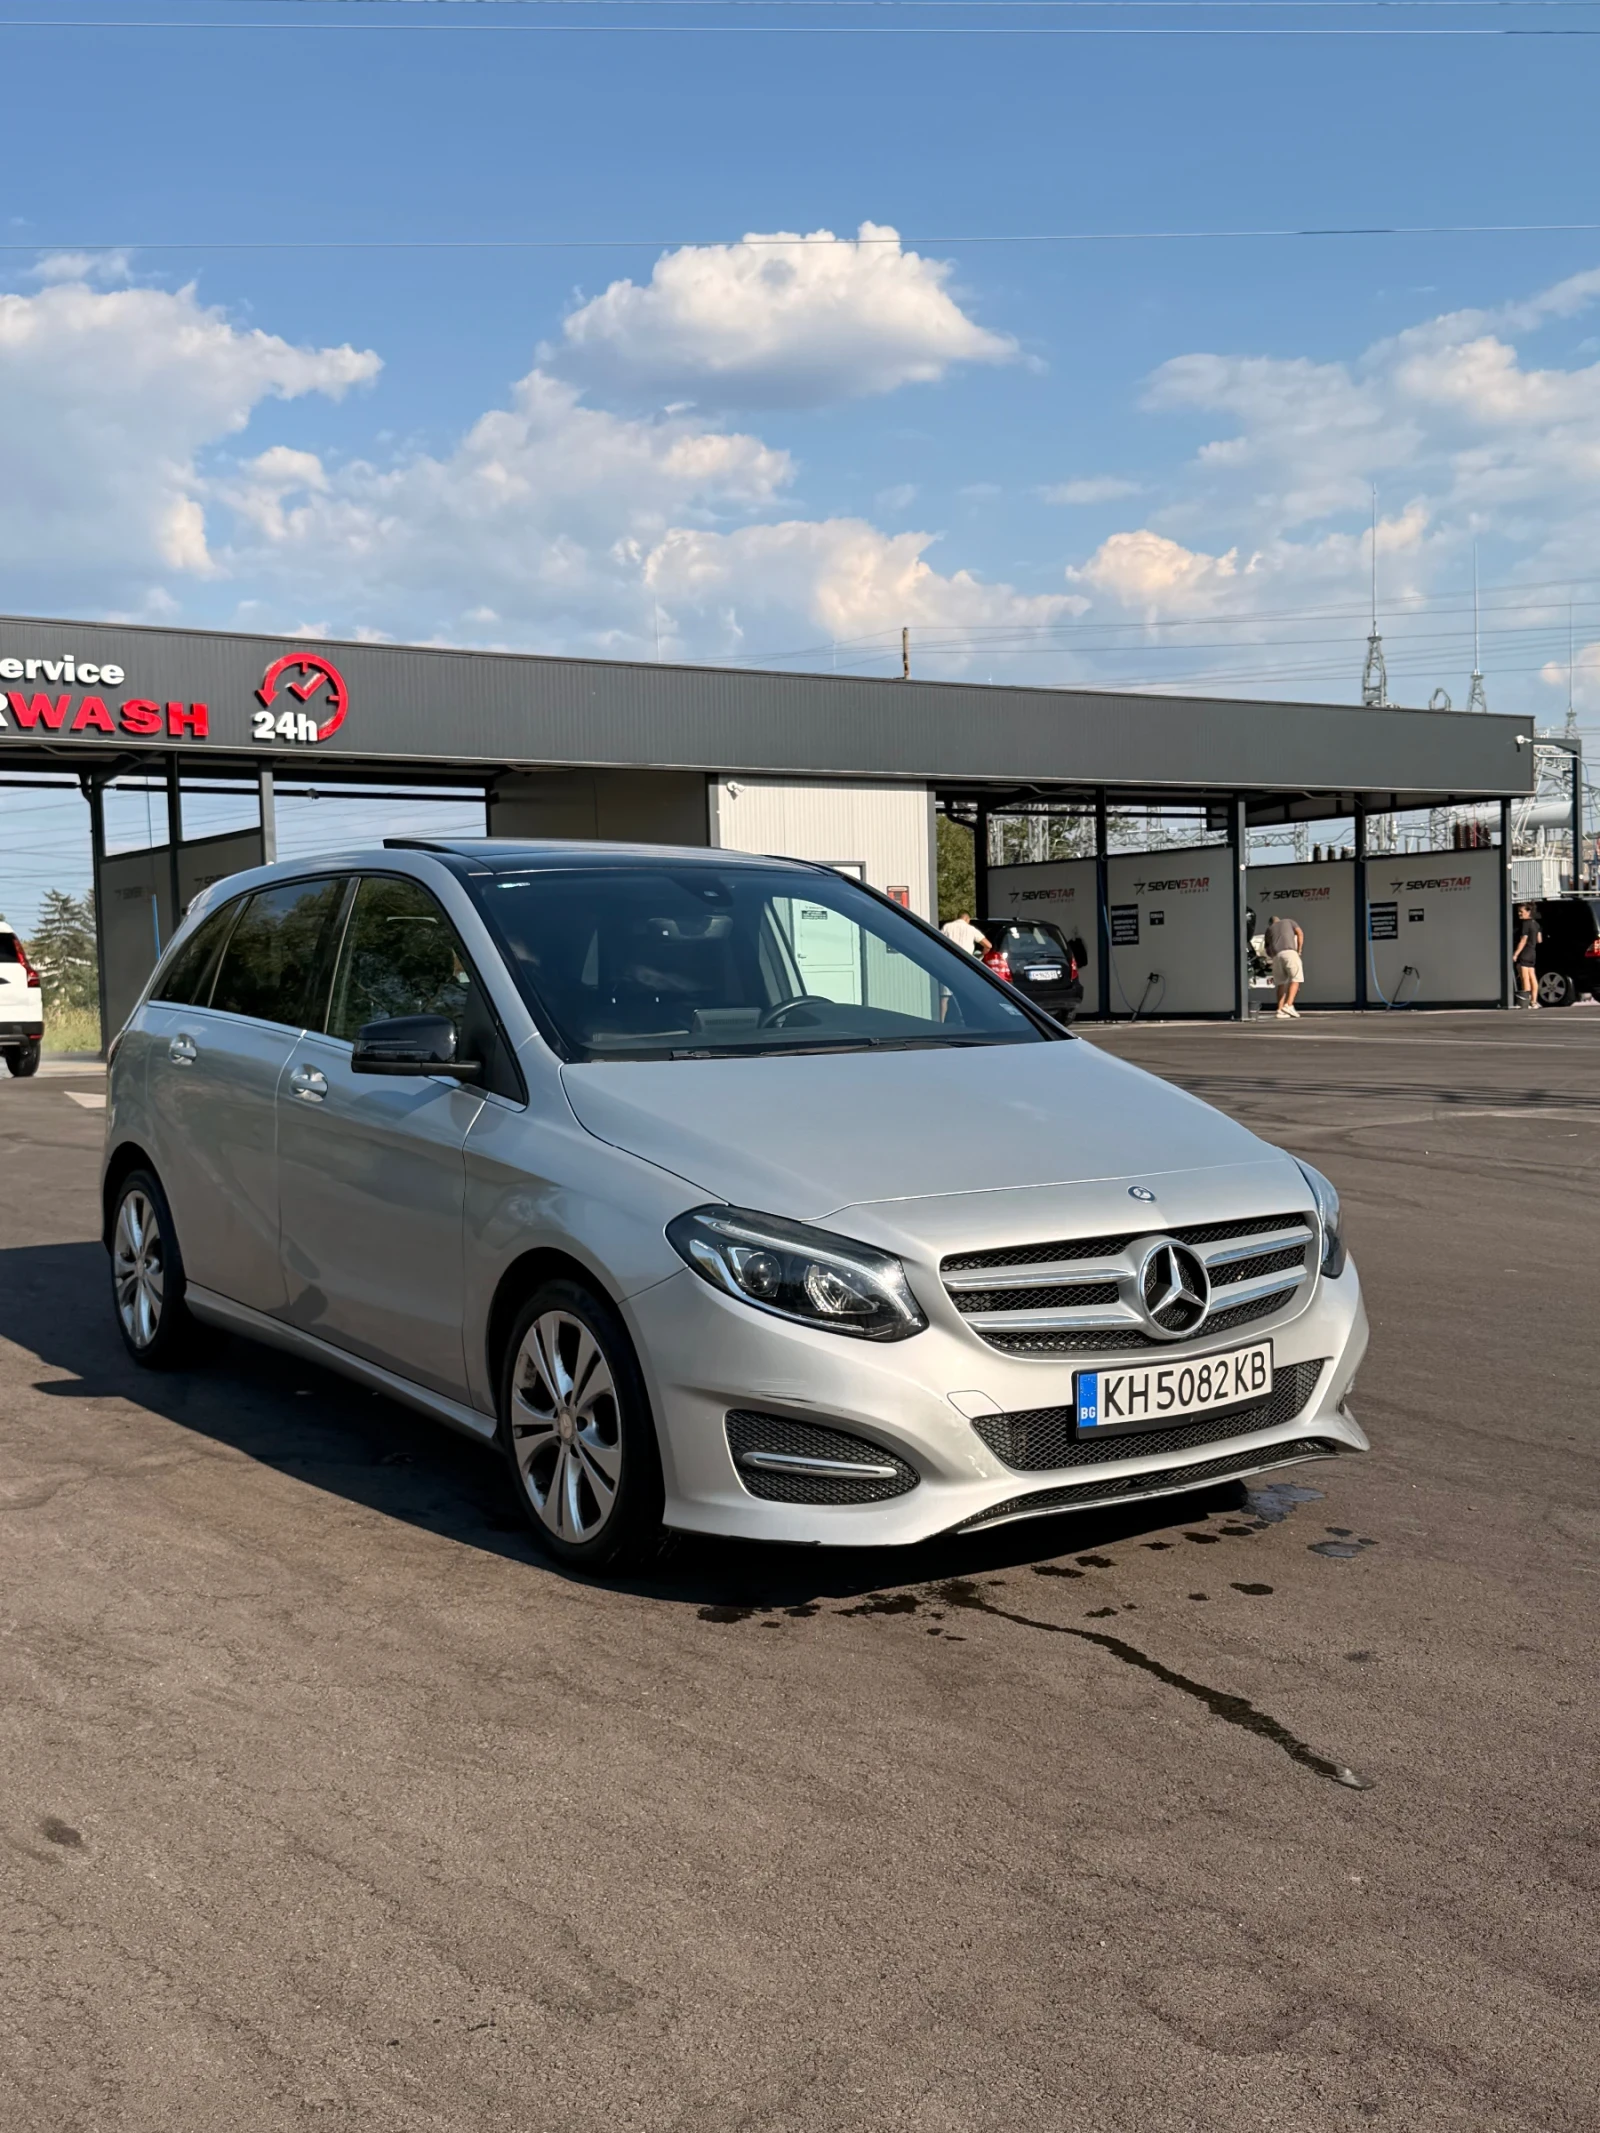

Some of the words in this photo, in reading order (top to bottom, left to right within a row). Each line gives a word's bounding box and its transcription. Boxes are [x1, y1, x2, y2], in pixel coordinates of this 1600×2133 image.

[253, 711, 318, 741] 24h
[1148, 877, 1209, 891] SEVENSTAR
[1406, 876, 1471, 890] SEVENSTAR
[1081, 1406, 1096, 1420] BG
